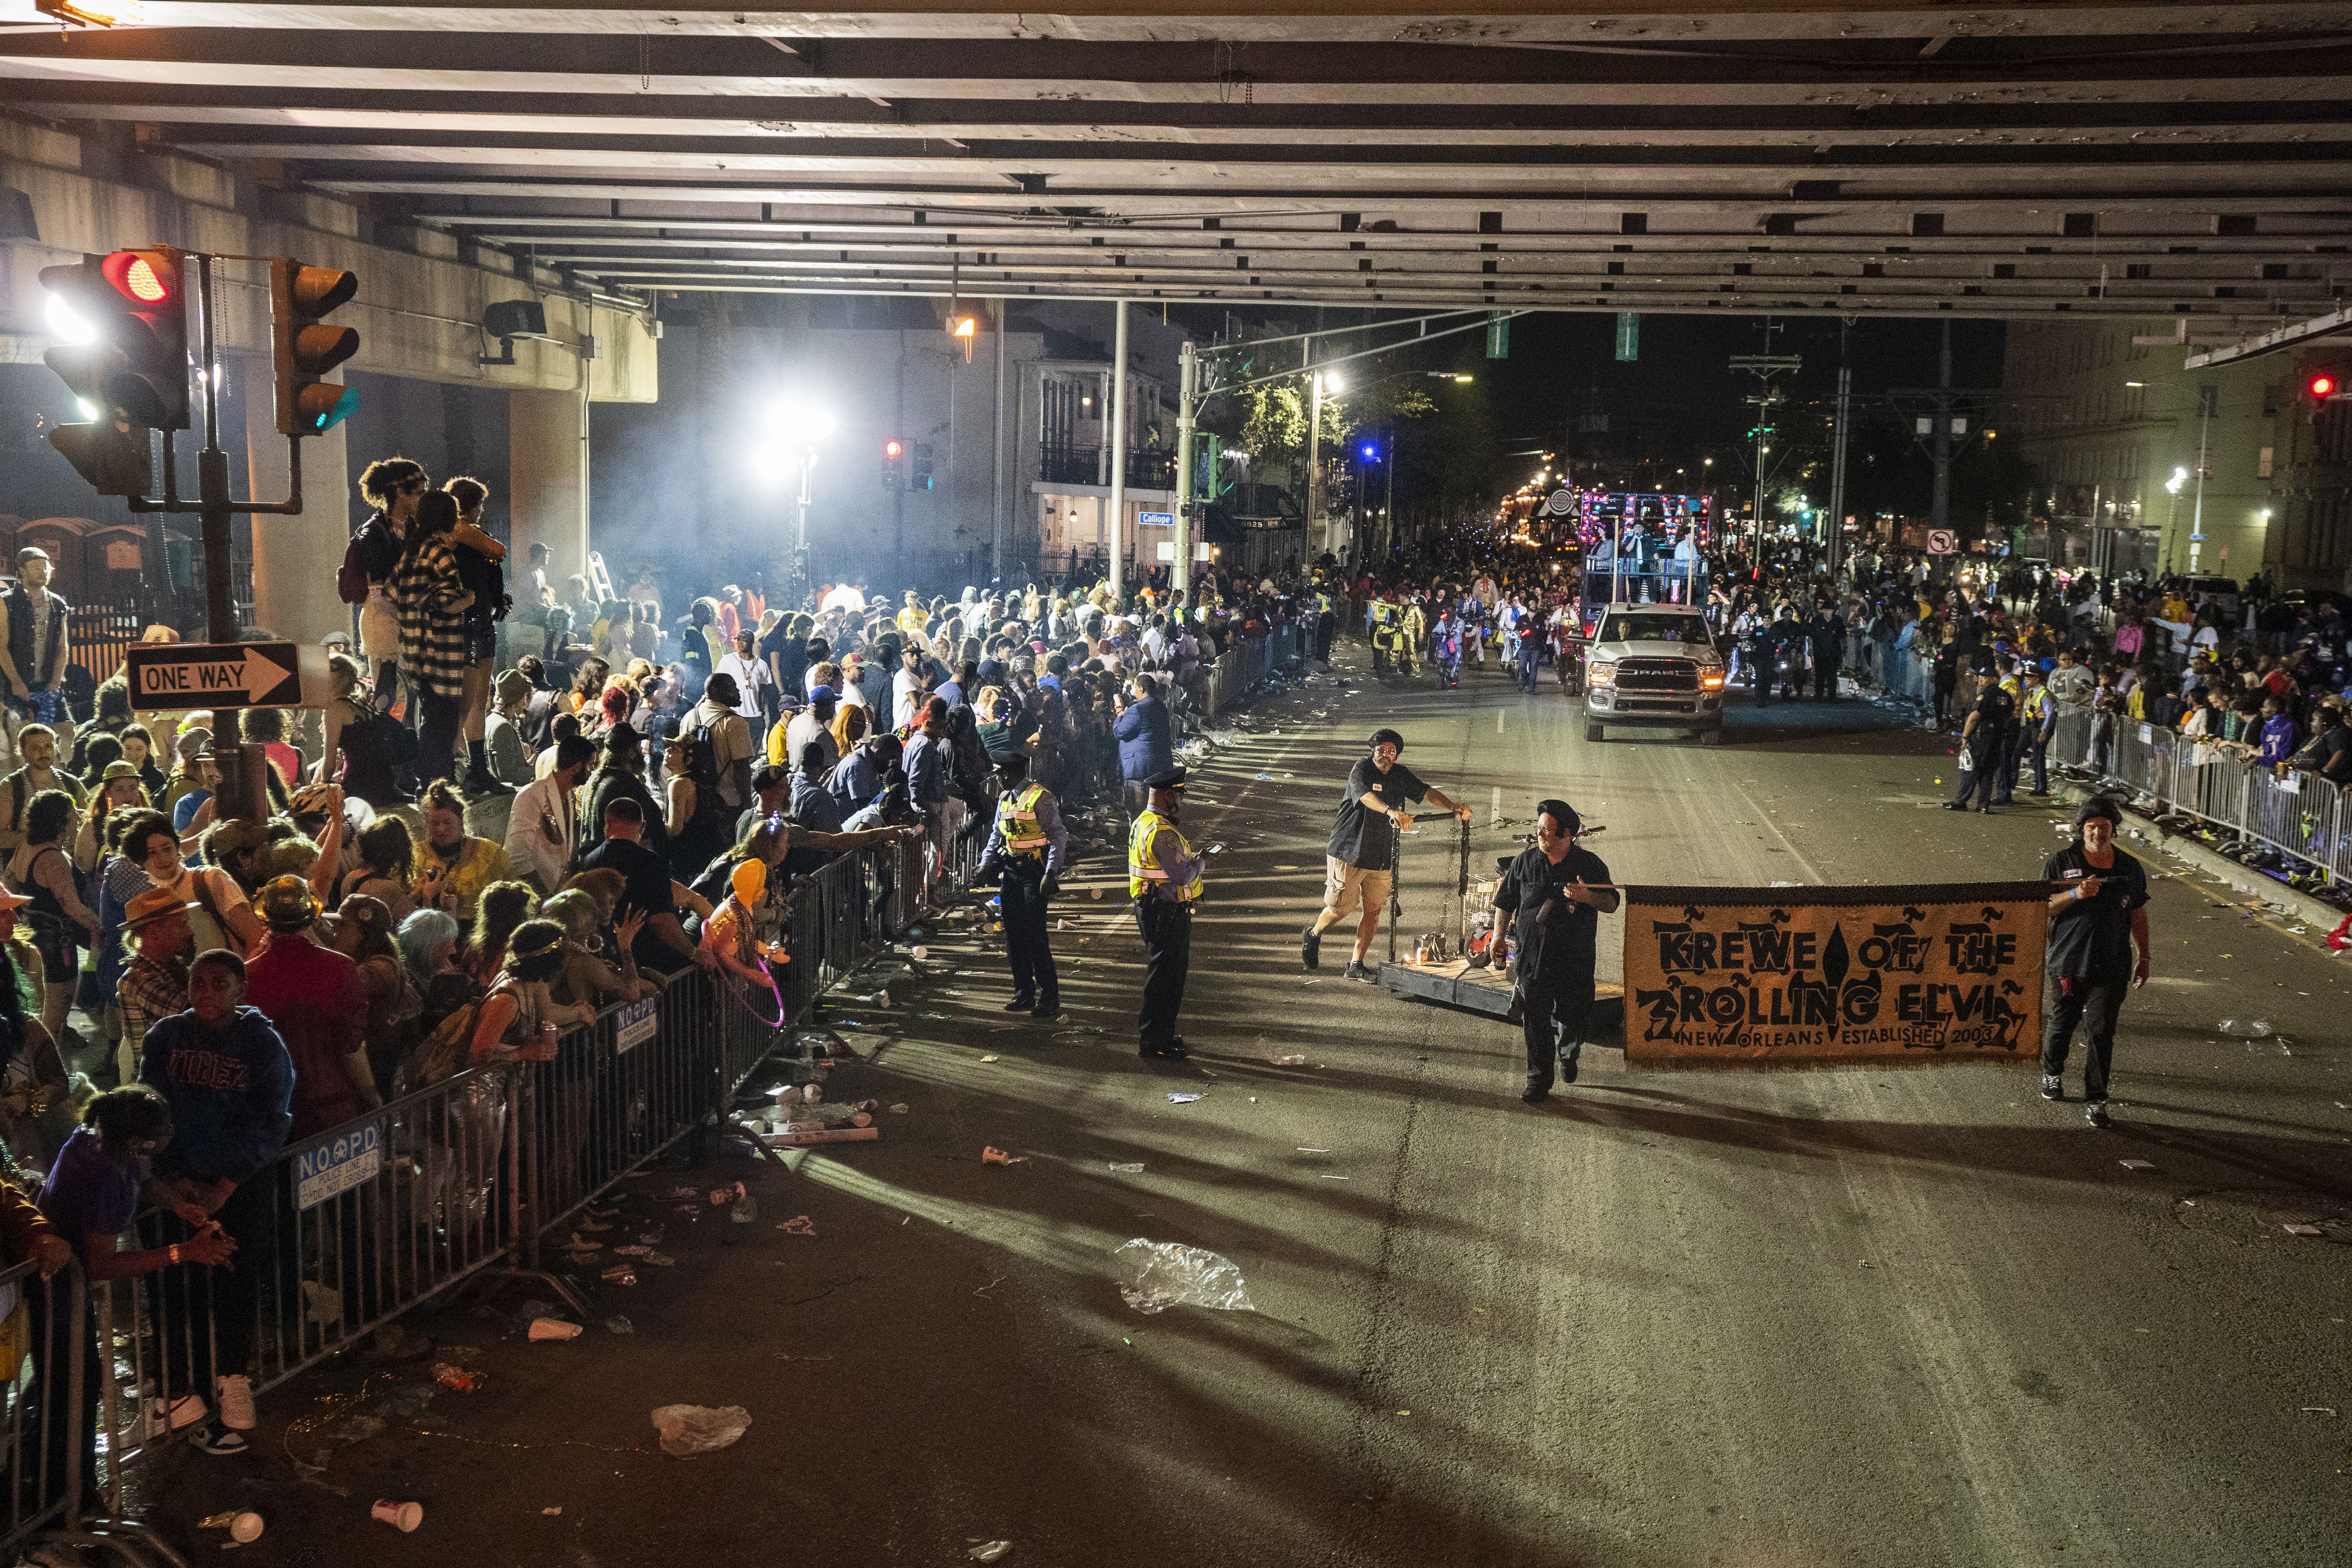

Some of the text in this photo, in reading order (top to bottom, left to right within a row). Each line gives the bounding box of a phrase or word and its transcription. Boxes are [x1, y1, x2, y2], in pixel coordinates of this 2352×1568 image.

[1143, 514, 1170, 524] Calliope
[146, 664, 245, 690] ONE WAY
[1660, 930, 2016, 969] KREWE OF THE
[1680, 983, 1995, 1026] ROLLING ELVI
[1680, 1028, 1992, 1048] NEW ORLEANS ESTABLISHED 2003
[313, 1186, 323, 1201] DO
[327, 1178, 340, 1194] NOT
[344, 1167, 365, 1187] CROSS
[319, 1165, 342, 1186] POLICE
[346, 1157, 360, 1173] LINE
